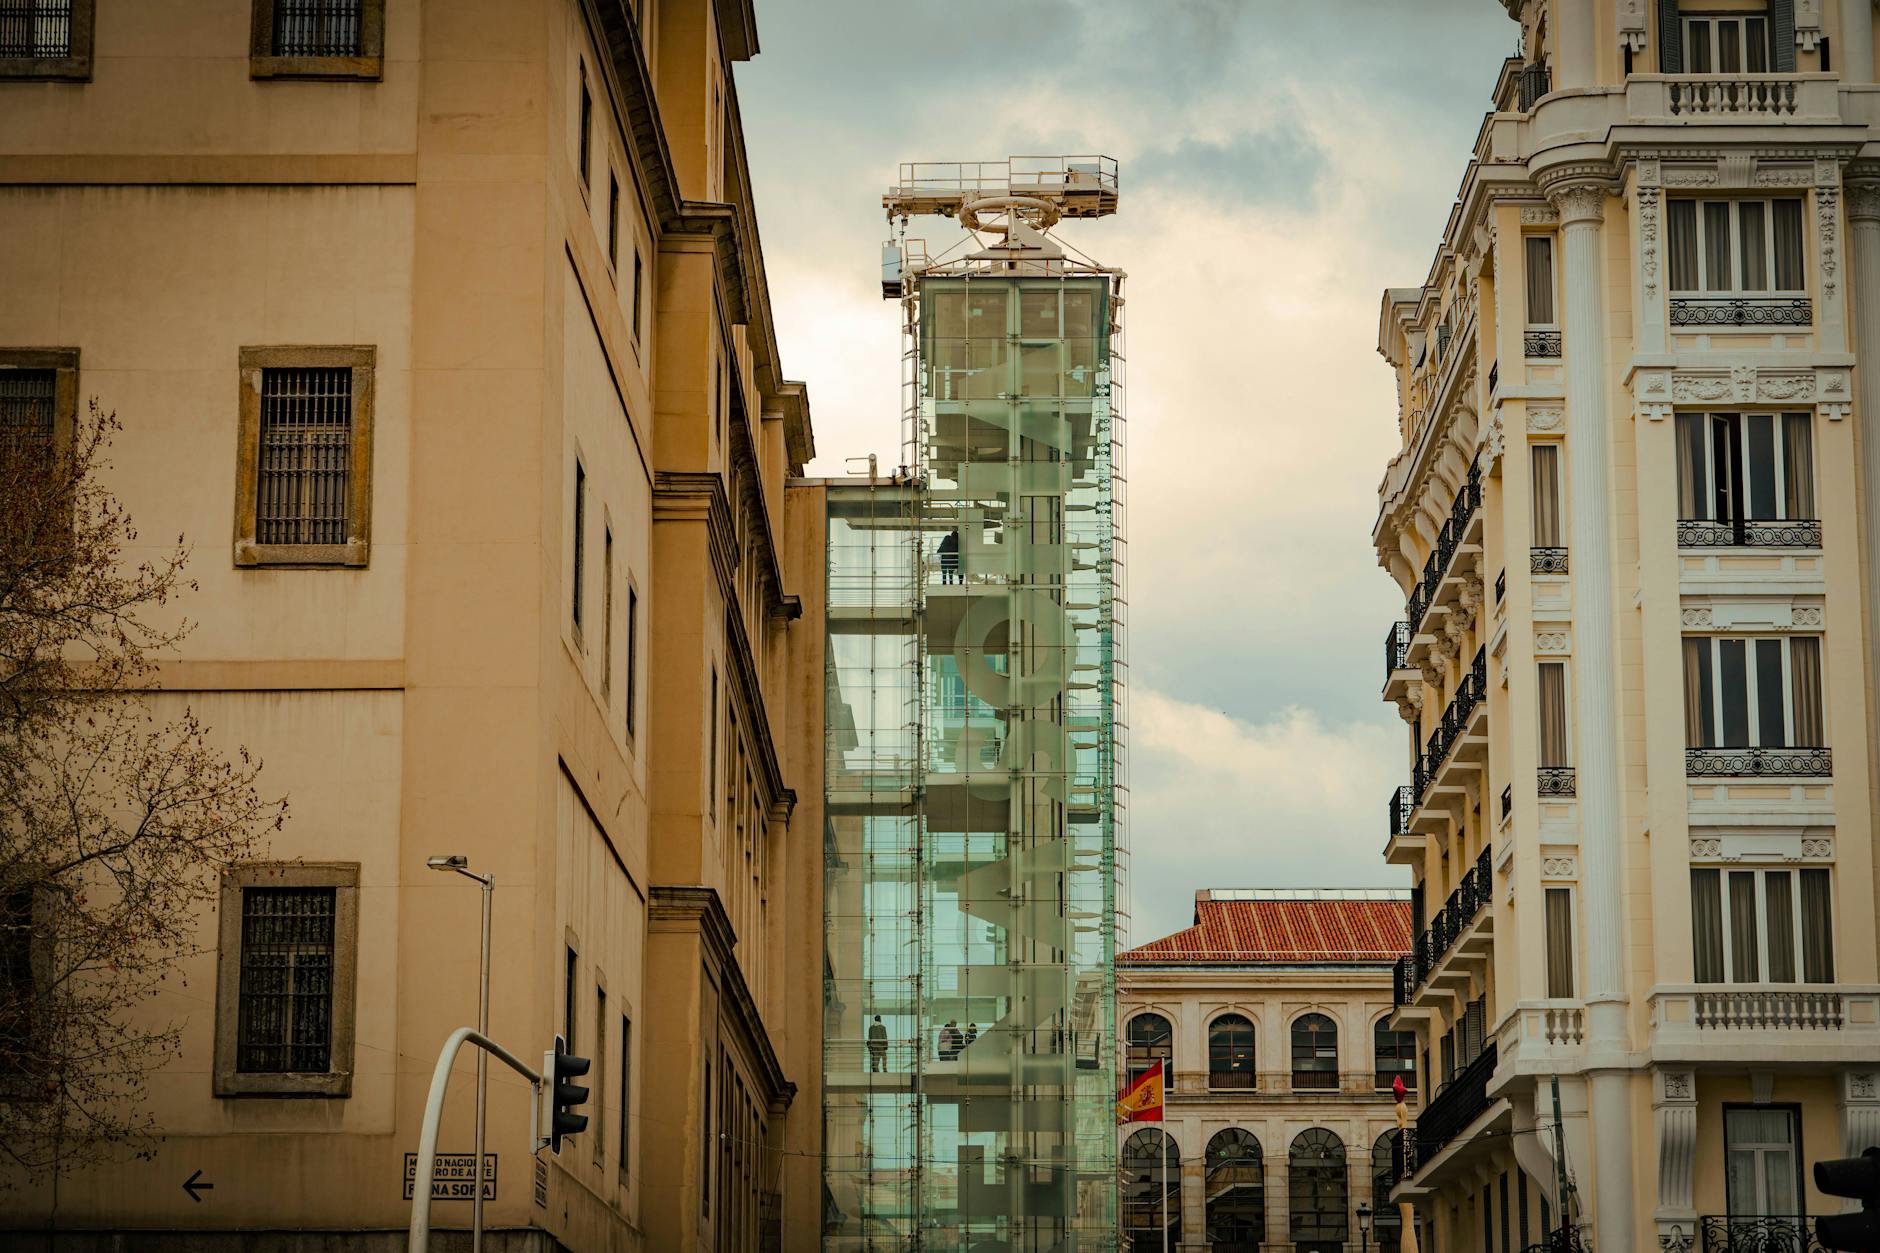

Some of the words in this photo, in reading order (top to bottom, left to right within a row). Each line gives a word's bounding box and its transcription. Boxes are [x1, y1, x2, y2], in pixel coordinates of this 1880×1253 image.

[957, 836, 1077, 1253] EINA
[409, 1168, 449, 1177] CRO
[451, 1168, 464, 1177] DE
[452, 1184, 491, 1196] SOFA
